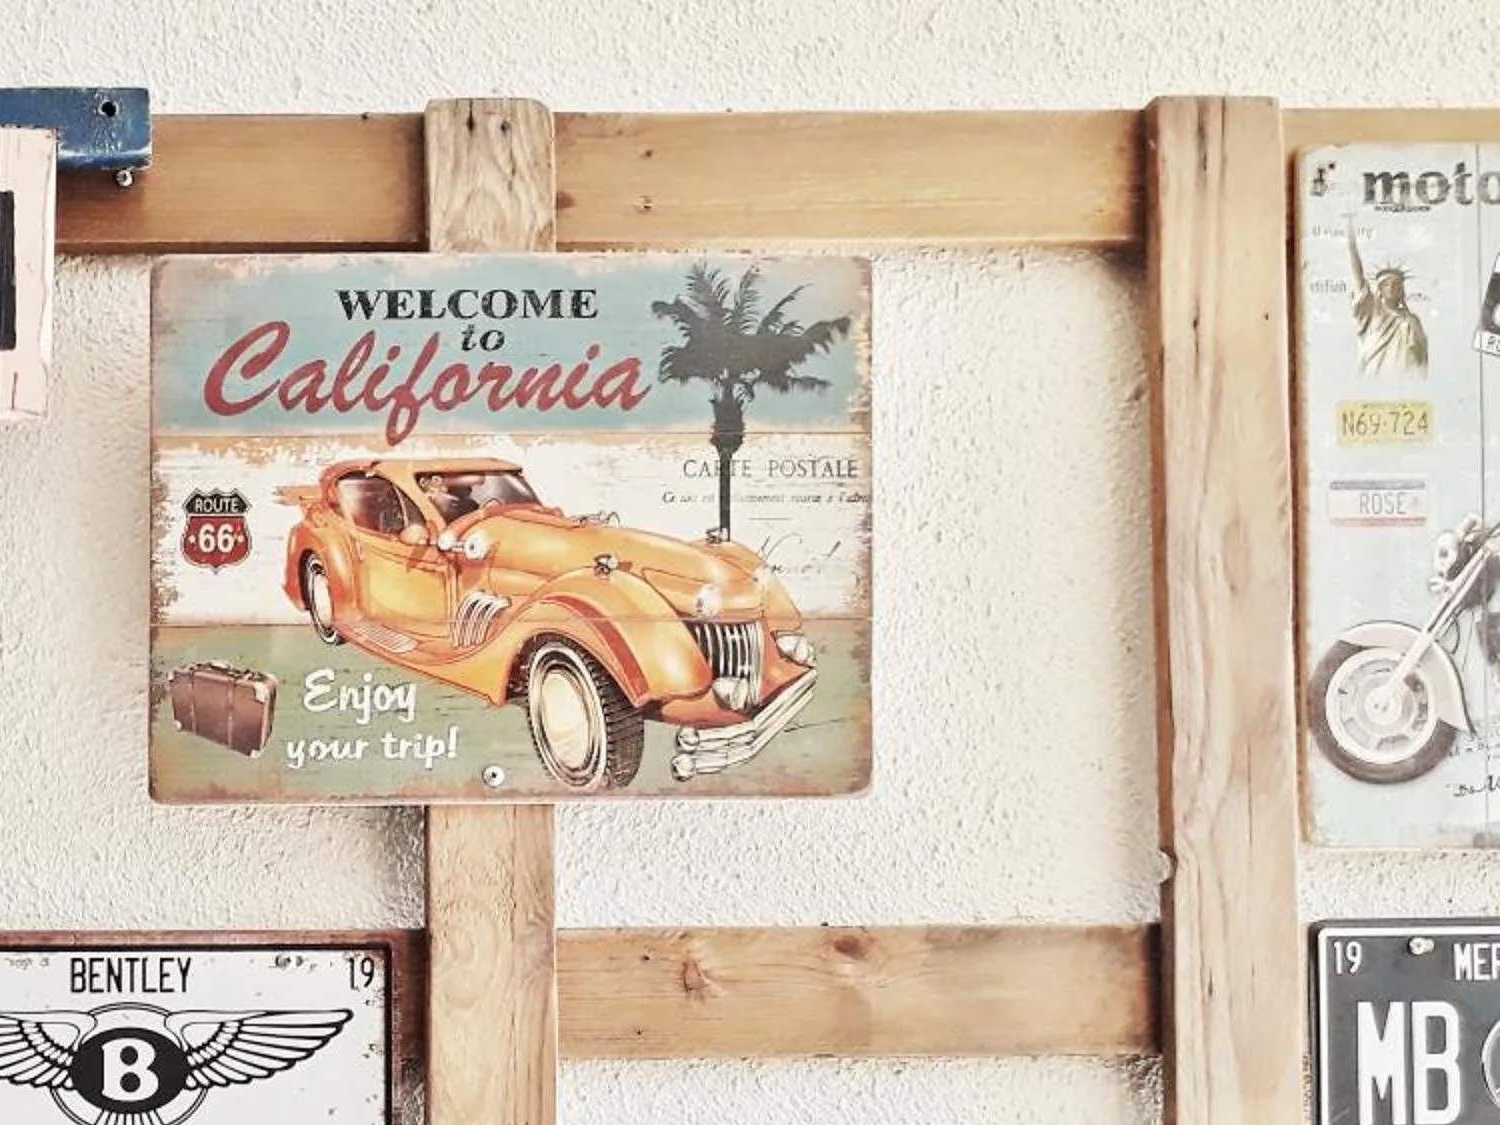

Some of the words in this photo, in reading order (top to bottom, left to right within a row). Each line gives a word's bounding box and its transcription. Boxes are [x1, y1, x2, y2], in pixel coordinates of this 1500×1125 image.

[1362, 161, 1500, 206] moto
[336, 287, 598, 322] WELCOME
[461, 323, 506, 353] to
[203, 320, 654, 448] California
[769, 458, 860, 479] POSTALE
[194, 497, 240, 513] ROUTE
[1359, 491, 1408, 515] ROSE
[198, 523, 235, 553] 66
[303, 667, 418, 725] Enjoy
[286, 738, 370, 769] your
[380, 725, 460, 770] trip!
[69, 957, 192, 993] BENTLEY
[348, 957, 375, 989] 19
[1333, 941, 1363, 975] 19
[100, 1036, 162, 1102] B
